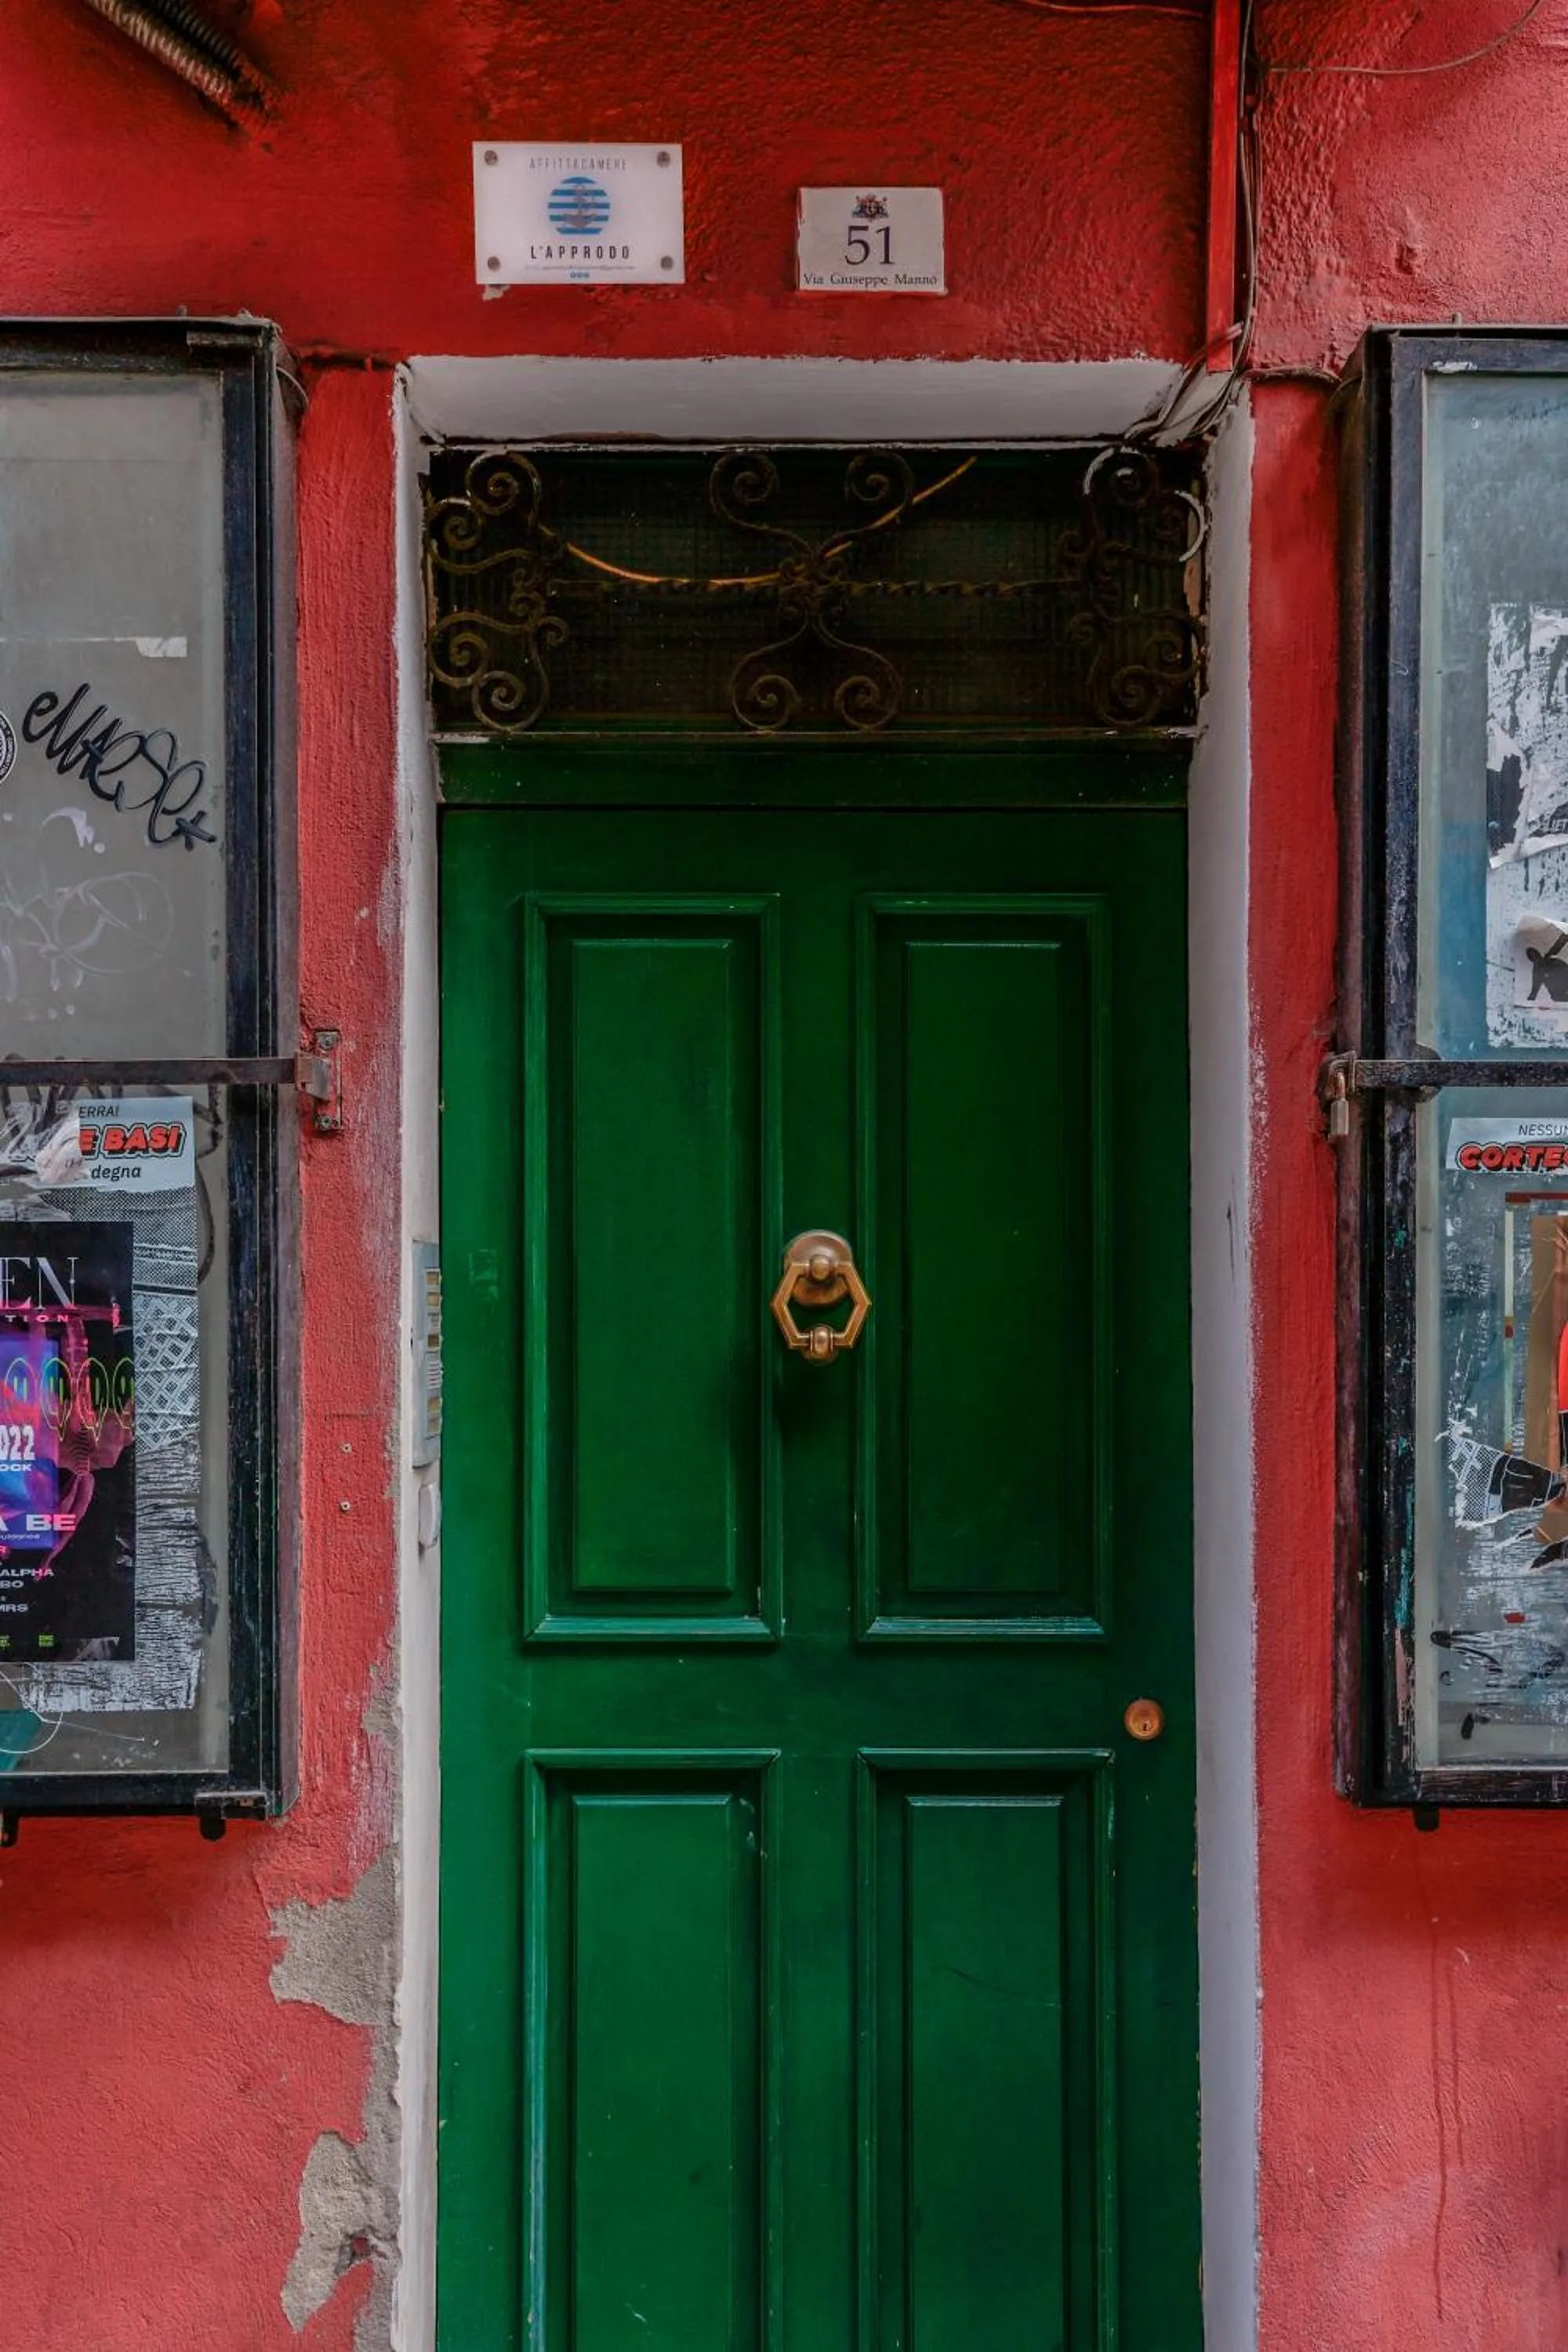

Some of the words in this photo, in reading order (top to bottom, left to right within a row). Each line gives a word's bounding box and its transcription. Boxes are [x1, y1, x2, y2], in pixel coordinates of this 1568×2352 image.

[531, 245, 630, 260] L'APPRODO
[844, 225, 895, 265] 51
[804, 274, 823, 285] Via
[830, 273, 888, 288] Giuseppe
[895, 274, 937, 285] Manno
[101, 1124, 184, 1156] BASI
[1459, 1145, 1568, 1171] CORTE
[91, 1165, 141, 1180] degna
[27, 1514, 75, 1531] BE
